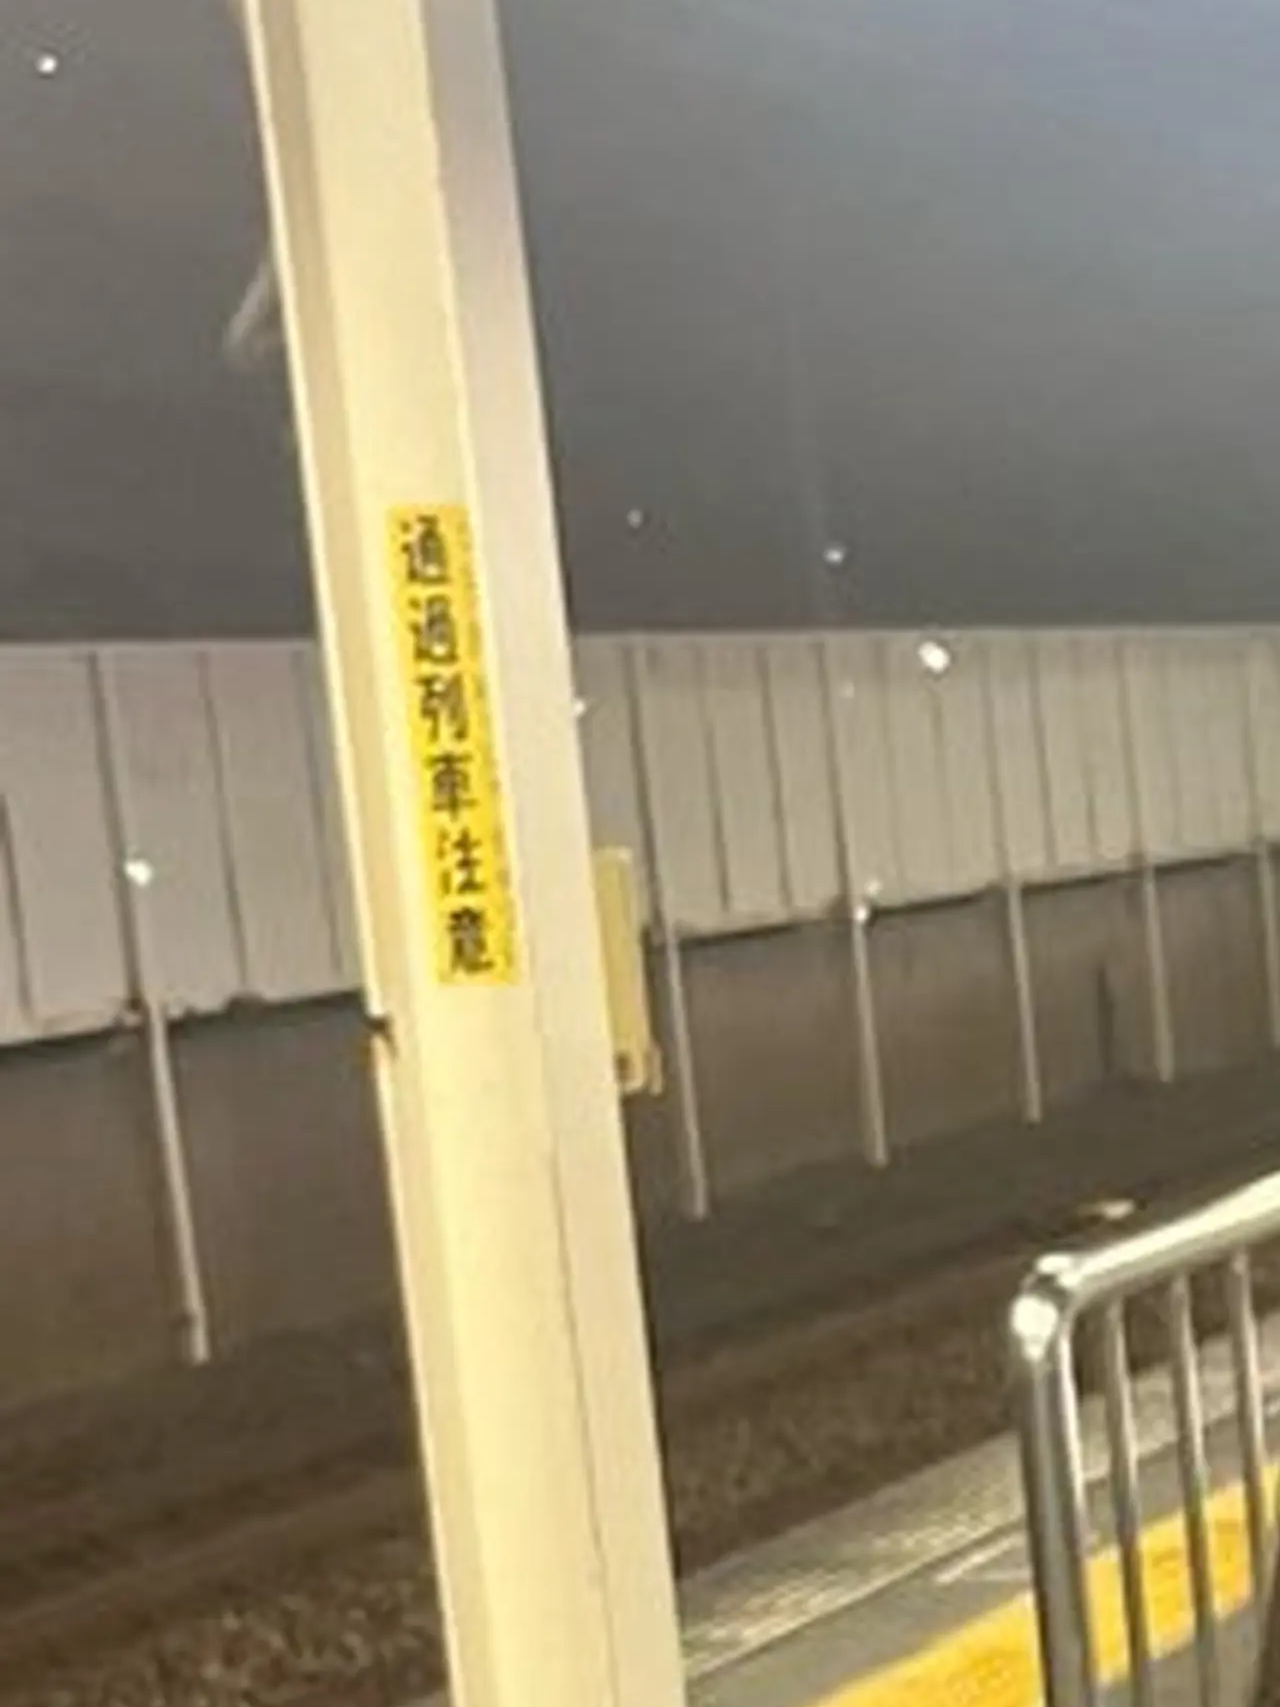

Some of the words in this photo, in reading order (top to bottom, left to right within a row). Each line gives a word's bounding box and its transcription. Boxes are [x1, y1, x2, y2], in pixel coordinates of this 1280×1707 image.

[401, 515, 495, 975] 通過列車注意
